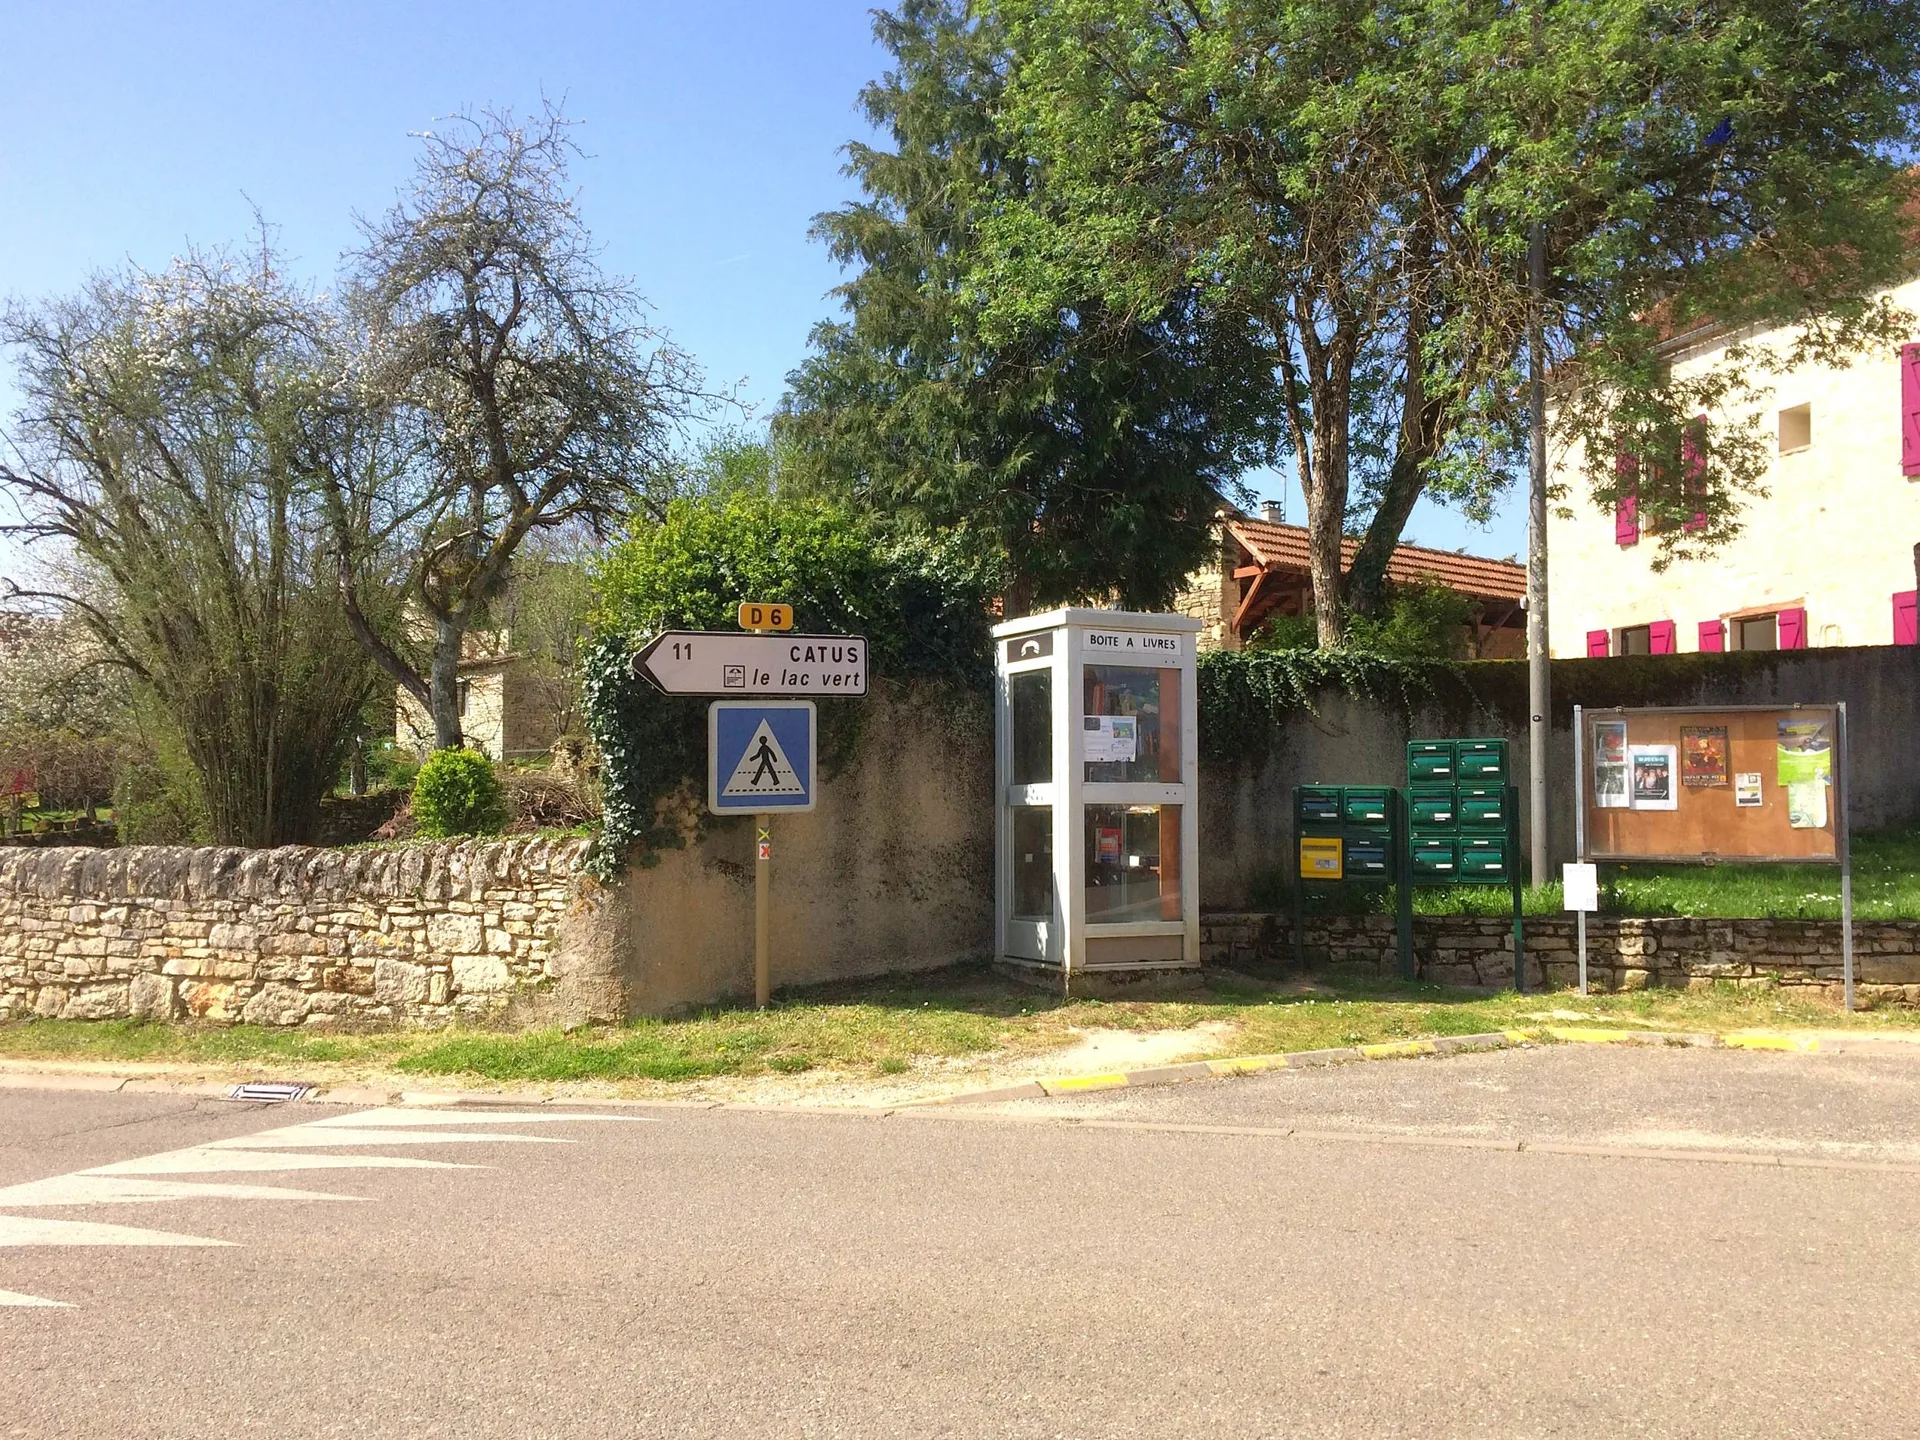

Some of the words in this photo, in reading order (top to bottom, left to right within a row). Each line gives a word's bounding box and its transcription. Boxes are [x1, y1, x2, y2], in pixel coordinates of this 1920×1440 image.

[751, 608, 762, 625] D
[770, 609, 782, 625] 6
[1090, 634, 1119, 647] BOITE
[1126, 637, 1134, 647] A
[1143, 637, 1176, 650] LIVRES
[672, 642, 692, 661] 11
[790, 646, 859, 663] CATUS
[753, 668, 770, 685] le
[781, 669, 810, 686] lac
[822, 672, 860, 687] vert
